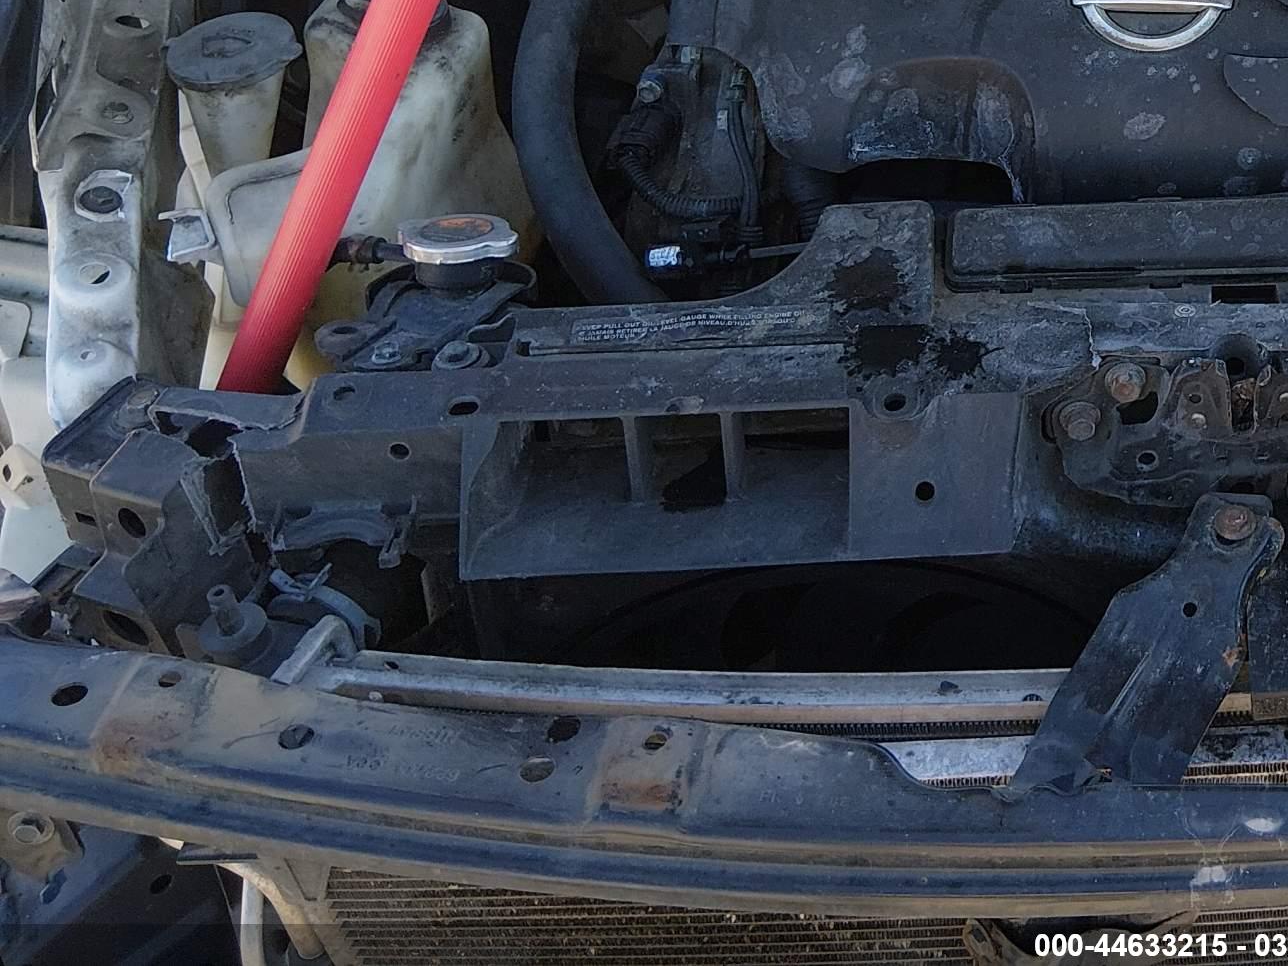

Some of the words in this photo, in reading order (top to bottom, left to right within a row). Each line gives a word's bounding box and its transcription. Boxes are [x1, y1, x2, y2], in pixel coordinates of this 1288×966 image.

[603, 322, 621, 330] PULL
[680, 313, 707, 321] GAUGE
[697, 319, 727, 327] NIVEAU
